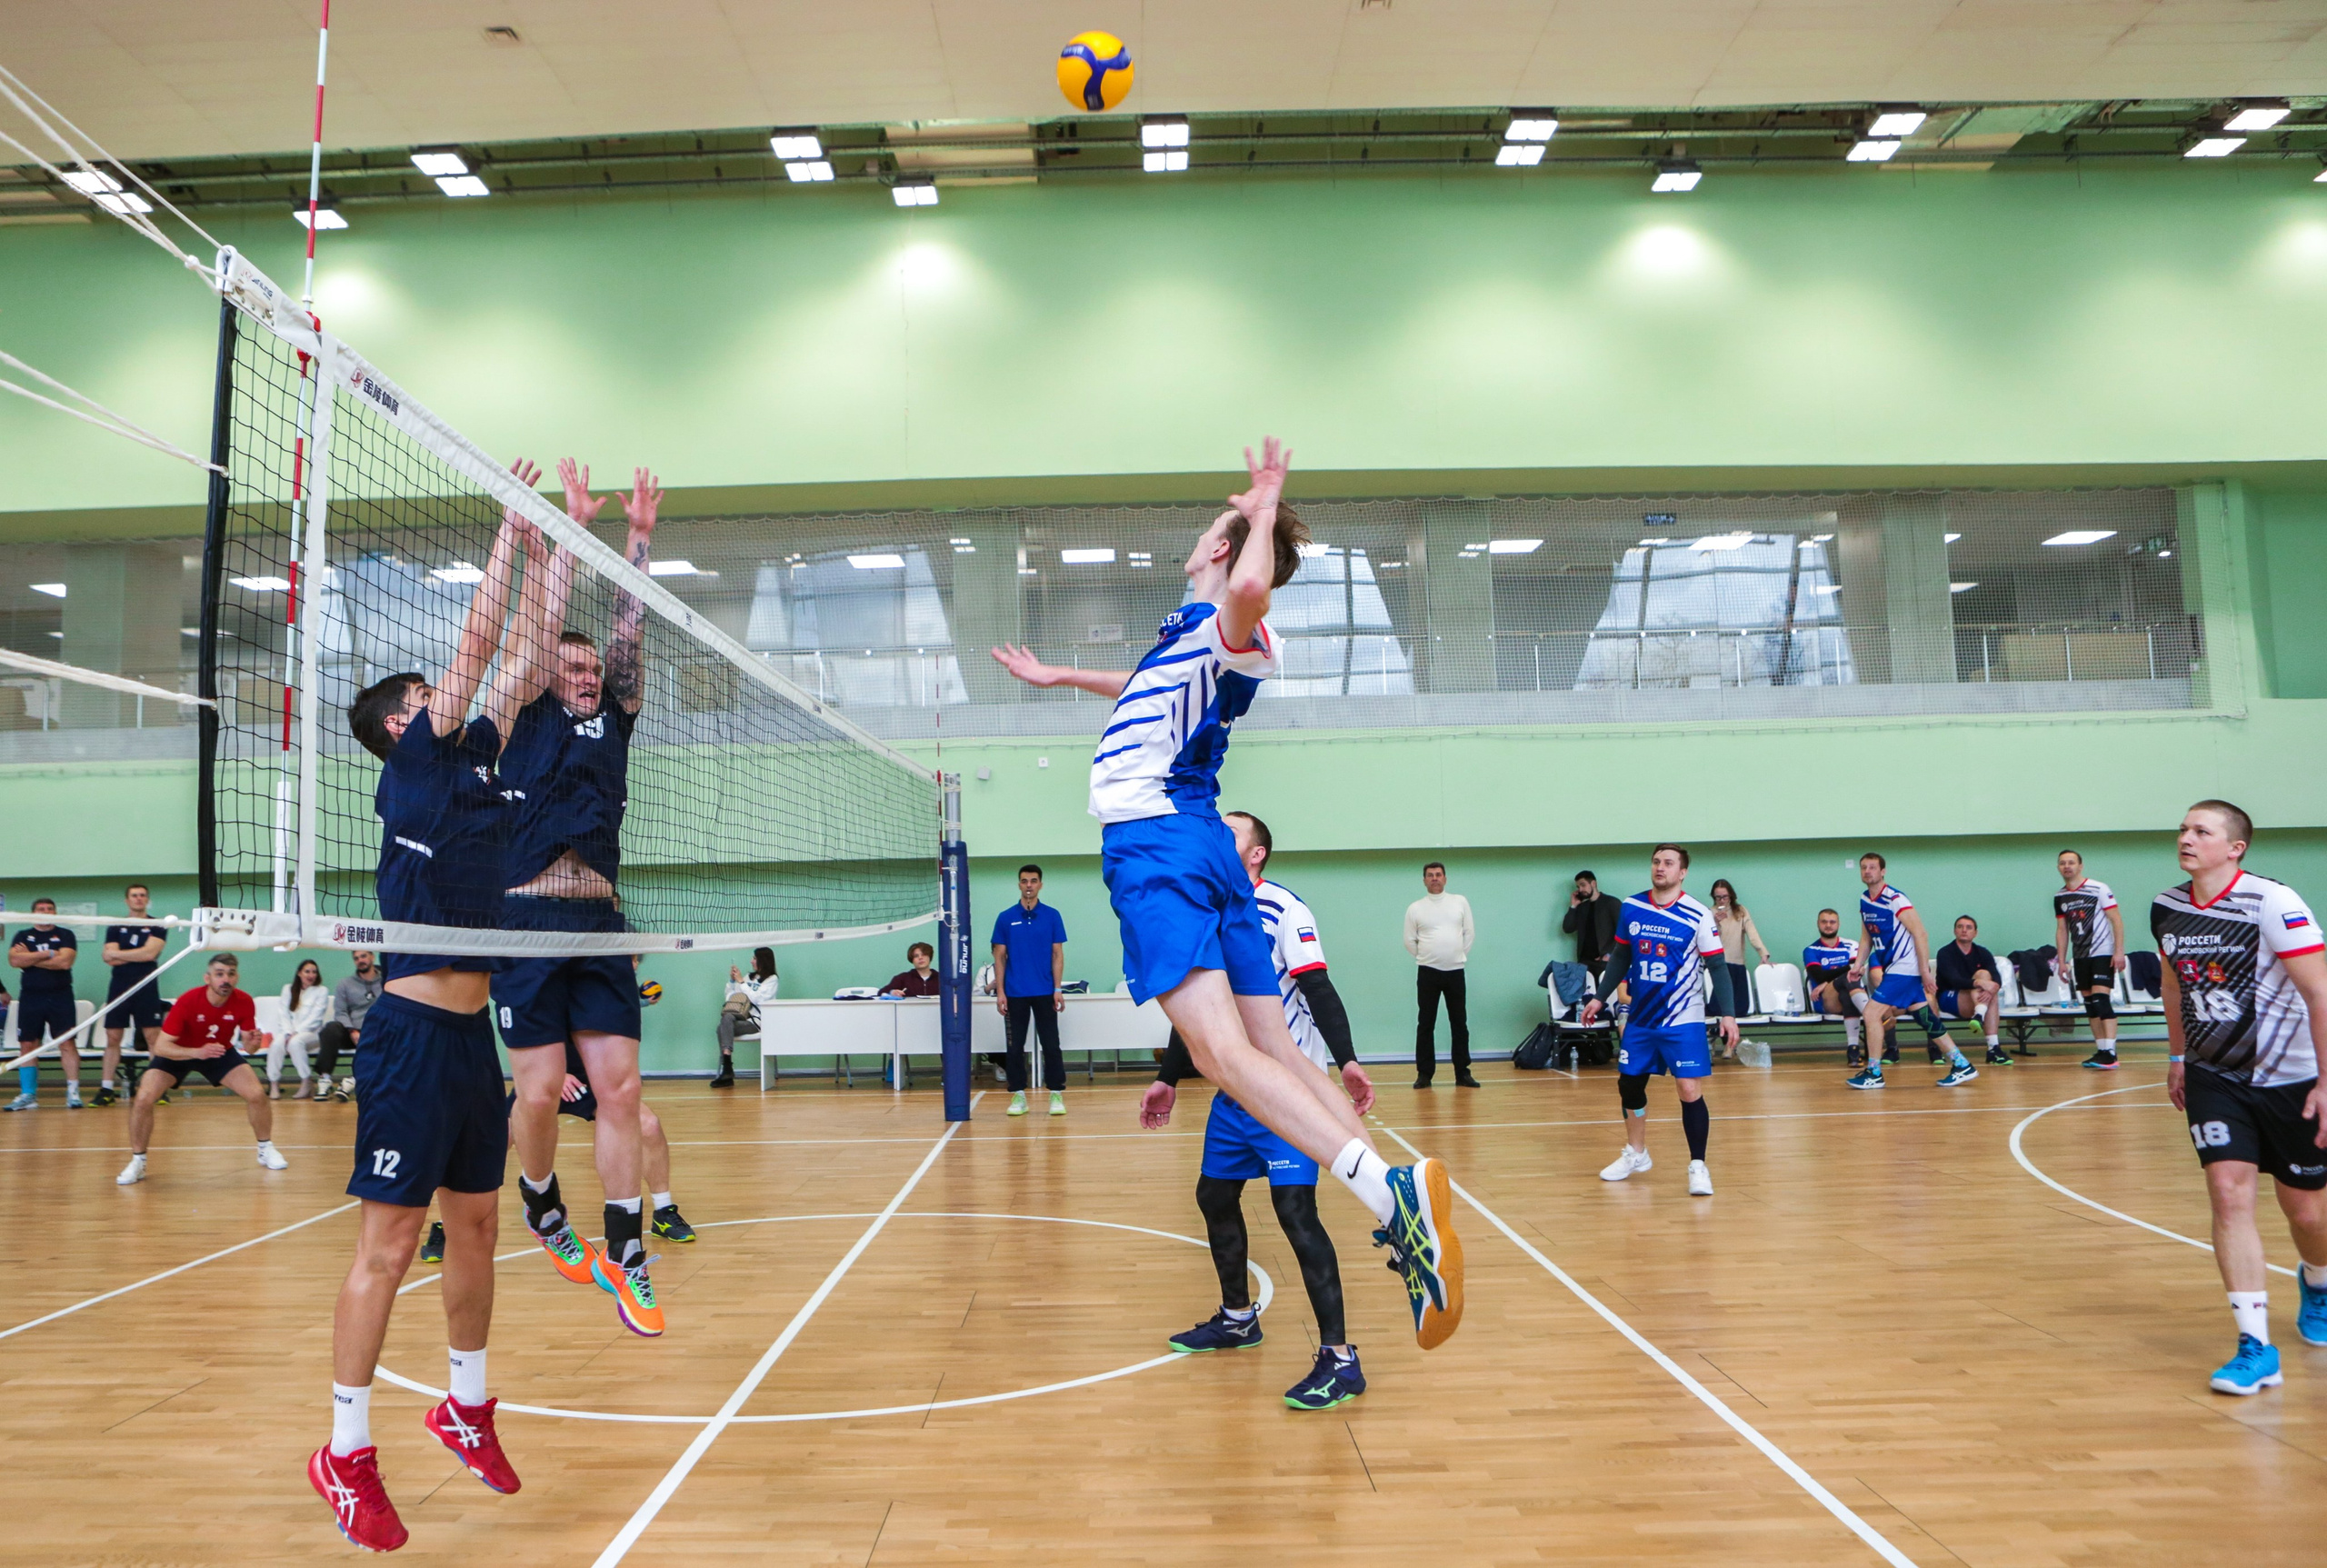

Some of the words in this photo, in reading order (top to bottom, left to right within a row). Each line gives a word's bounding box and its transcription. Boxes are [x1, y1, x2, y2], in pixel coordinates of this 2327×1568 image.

[363, 377, 400, 416] 金陵体育
[347, 925, 384, 944] 金陵体育
[1642, 924, 1671, 934] РОССЕТИ
[2075, 921, 2085, 935] 1
[2177, 946, 2218, 955] МОСКОВСКИЙ
[2218, 944, 2246, 953] РЕГИОН
[2178, 934, 2222, 945] РОССЕТИ
[1639, 960, 1668, 983] 12
[2189, 989, 2243, 1023] 18
[499, 1006, 513, 1029] 19
[205, 1024, 220, 1039] 2
[2190, 1120, 2232, 1149] 18
[372, 1147, 401, 1179] 12
